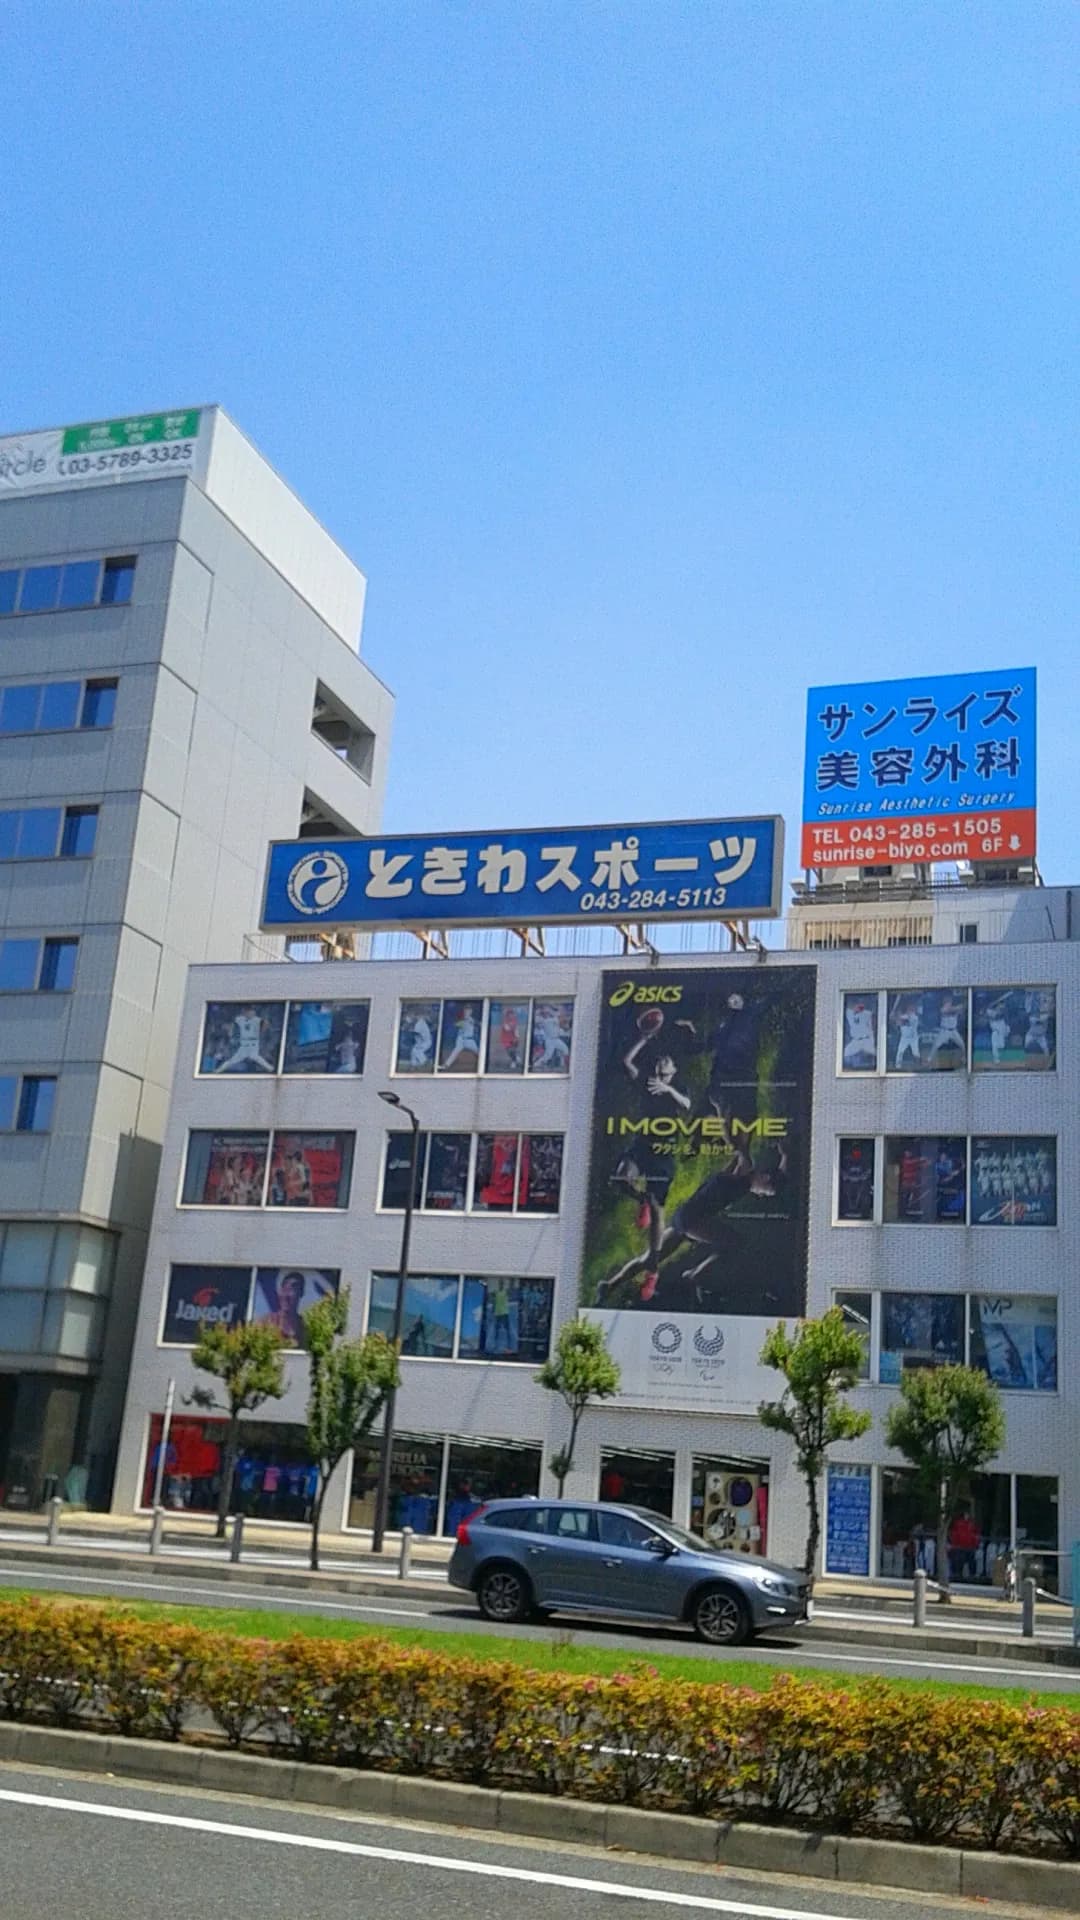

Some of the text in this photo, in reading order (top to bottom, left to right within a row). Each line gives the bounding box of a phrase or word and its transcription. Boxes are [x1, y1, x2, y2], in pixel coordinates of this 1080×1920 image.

[818, 685, 1023, 741] サンライズ
[816, 737, 1020, 792] 美容外科
[818, 792, 1016, 816] Sunrise Aesthetic Surgery
[812, 817, 1002, 845] TEL 043-285-1505
[812, 838, 1004, 864] sunrise-biyo.com 6F
[364, 836, 757, 899] ときわスポーツ
[580, 887, 727, 911] 043-284-5113
[606, 1117, 788, 1136] I MOVE ME
